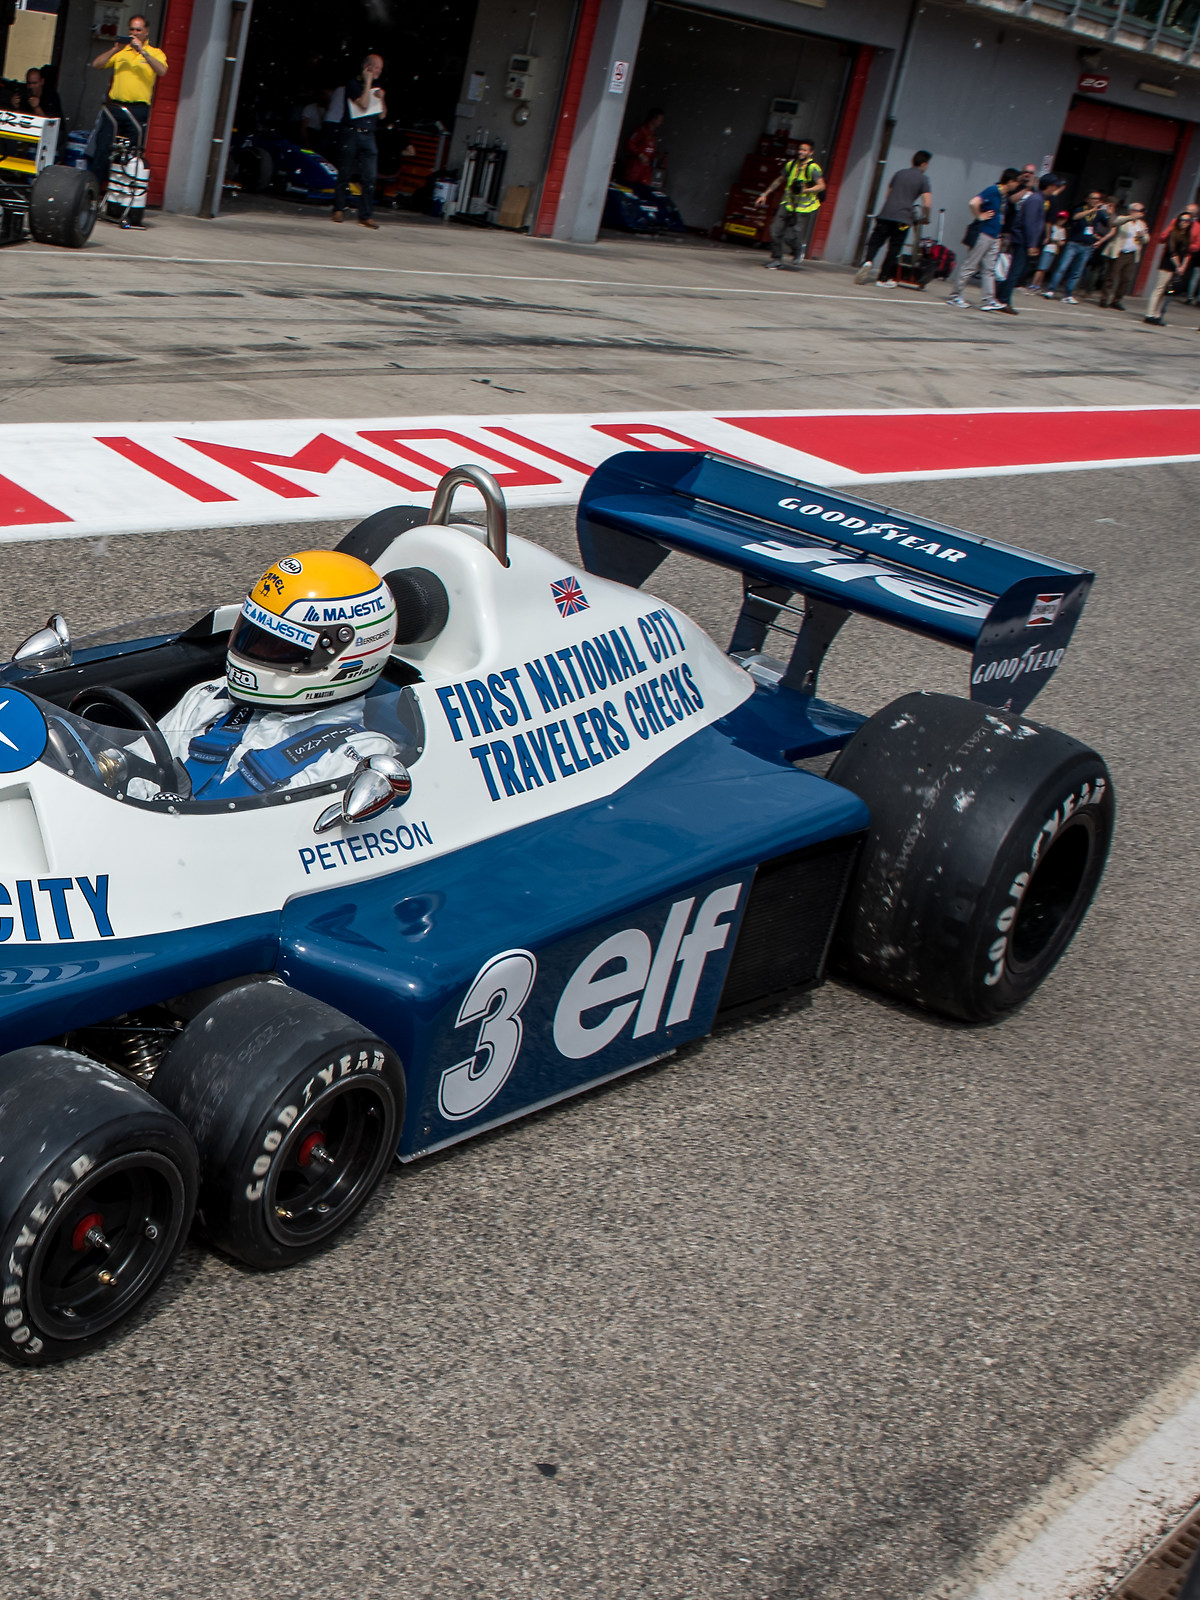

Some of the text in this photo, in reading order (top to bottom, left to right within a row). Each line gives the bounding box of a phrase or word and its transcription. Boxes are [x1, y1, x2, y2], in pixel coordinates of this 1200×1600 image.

[1080, 78, 1108, 88] 20
[777, 497, 967, 563] GOODYEAR
[261, 573, 284, 595] CAMEL
[323, 596, 386, 622] MAJESTIC
[256, 611, 315, 646] MAJESTIC
[435, 608, 687, 742] FIRST NATIONAL CITY
[971, 643, 1065, 685] GOODYEAR
[469, 663, 704, 802] TRAVELERS CHECKS
[298, 821, 434, 875] PETERSON
[983, 778, 1106, 987] GOODYEAR
[438, 883, 742, 1121] 3 elf
